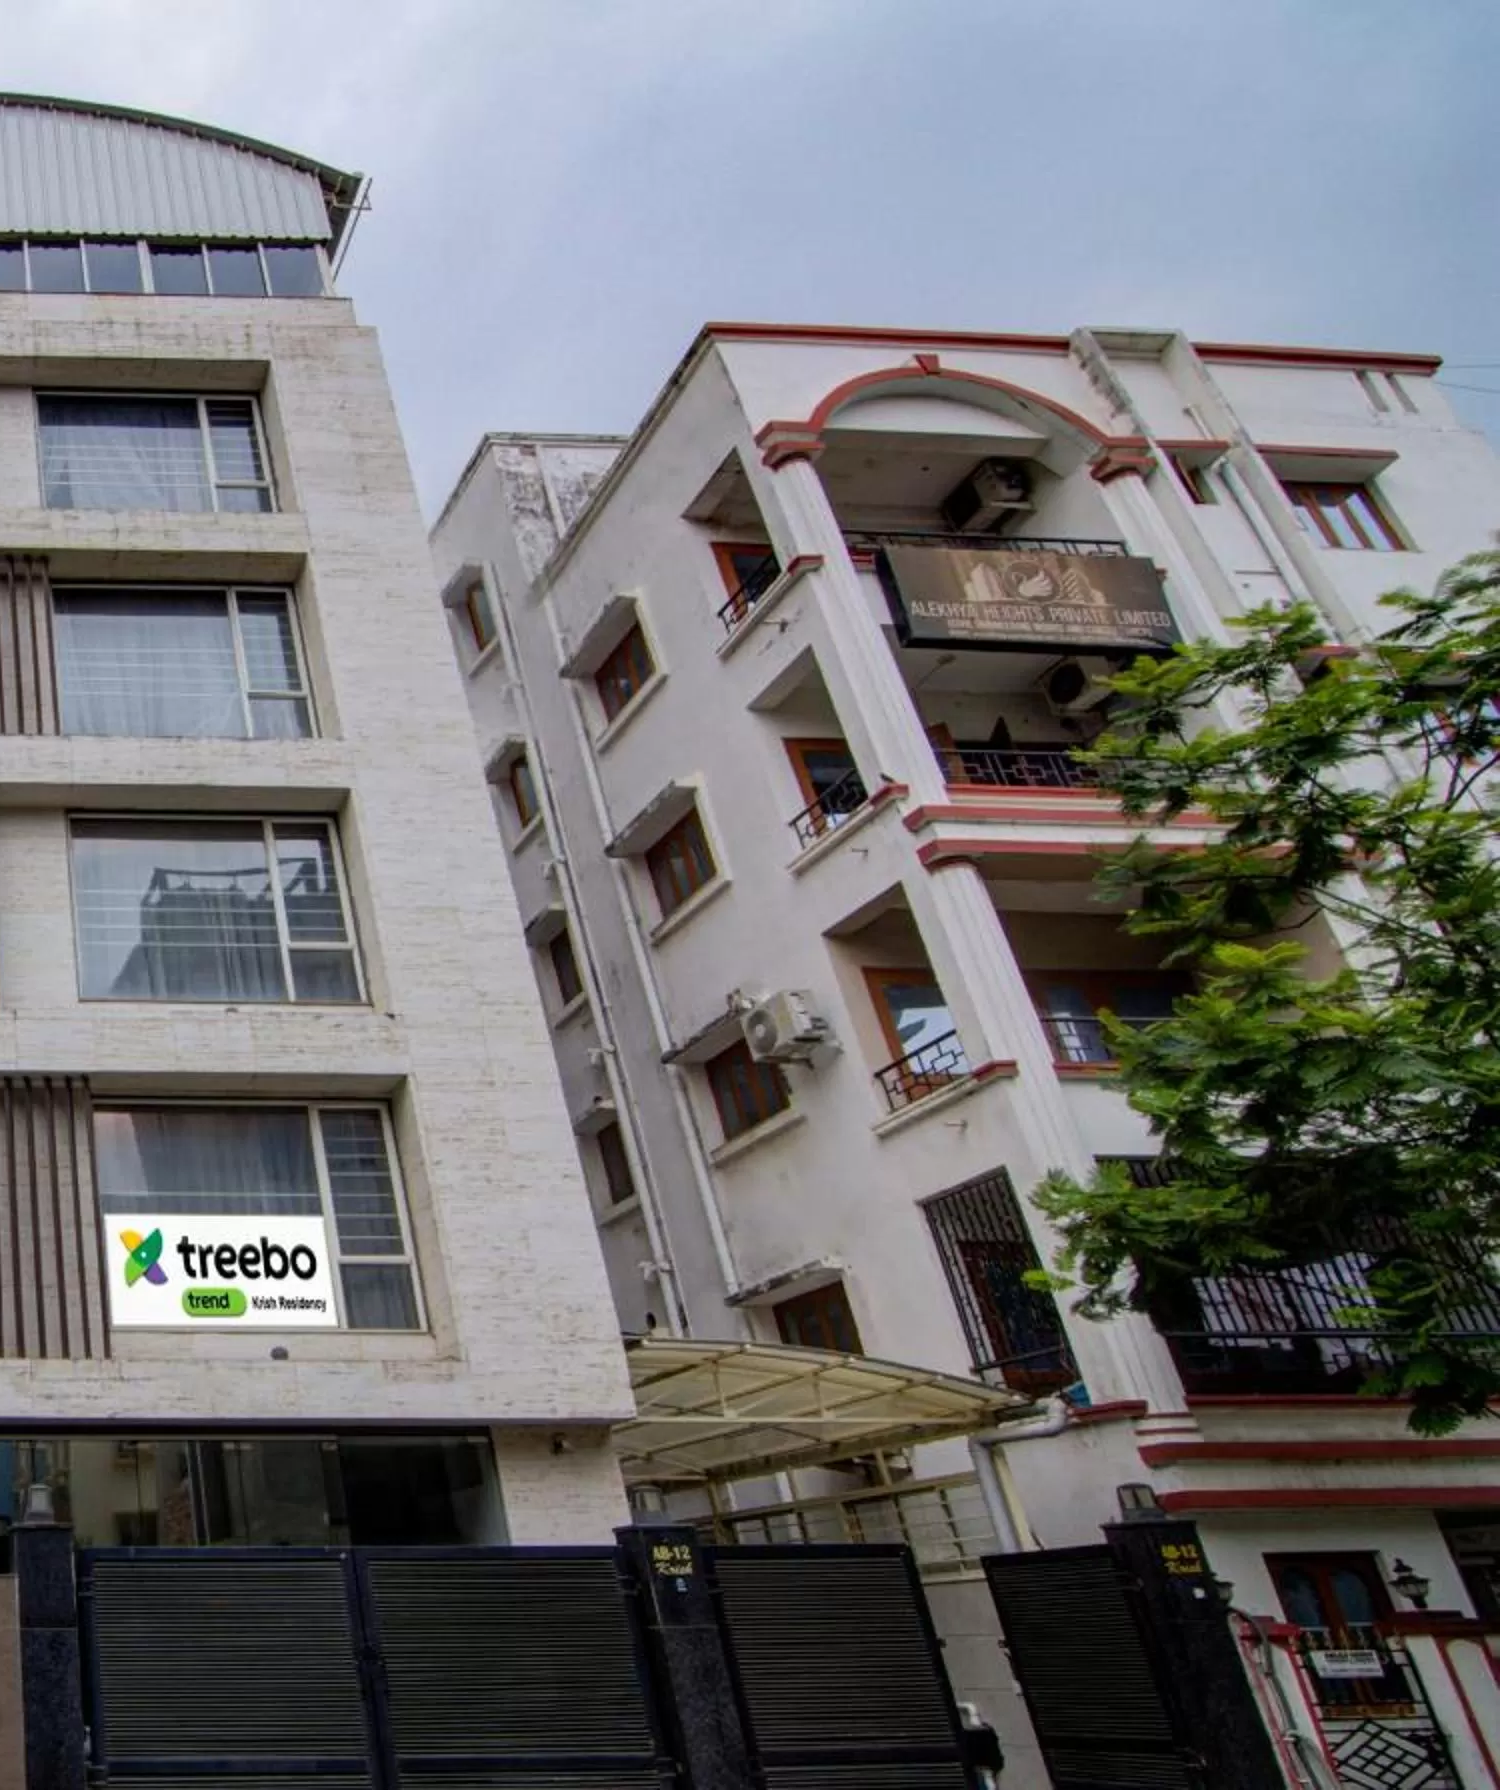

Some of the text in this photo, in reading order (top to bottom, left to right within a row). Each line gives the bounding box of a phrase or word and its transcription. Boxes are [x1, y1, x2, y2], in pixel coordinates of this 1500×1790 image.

[910, 600, 977, 619] ALEKHYA
[984, 605, 1043, 622] HEIGHTS
[1050, 607, 1110, 625] PRIVATE
[1114, 609, 1171, 627] LIMITED
[176, 1235, 317, 1280] treebo
[187, 1291, 230, 1310] trend
[251, 1296, 327, 1313] Krish Residency
